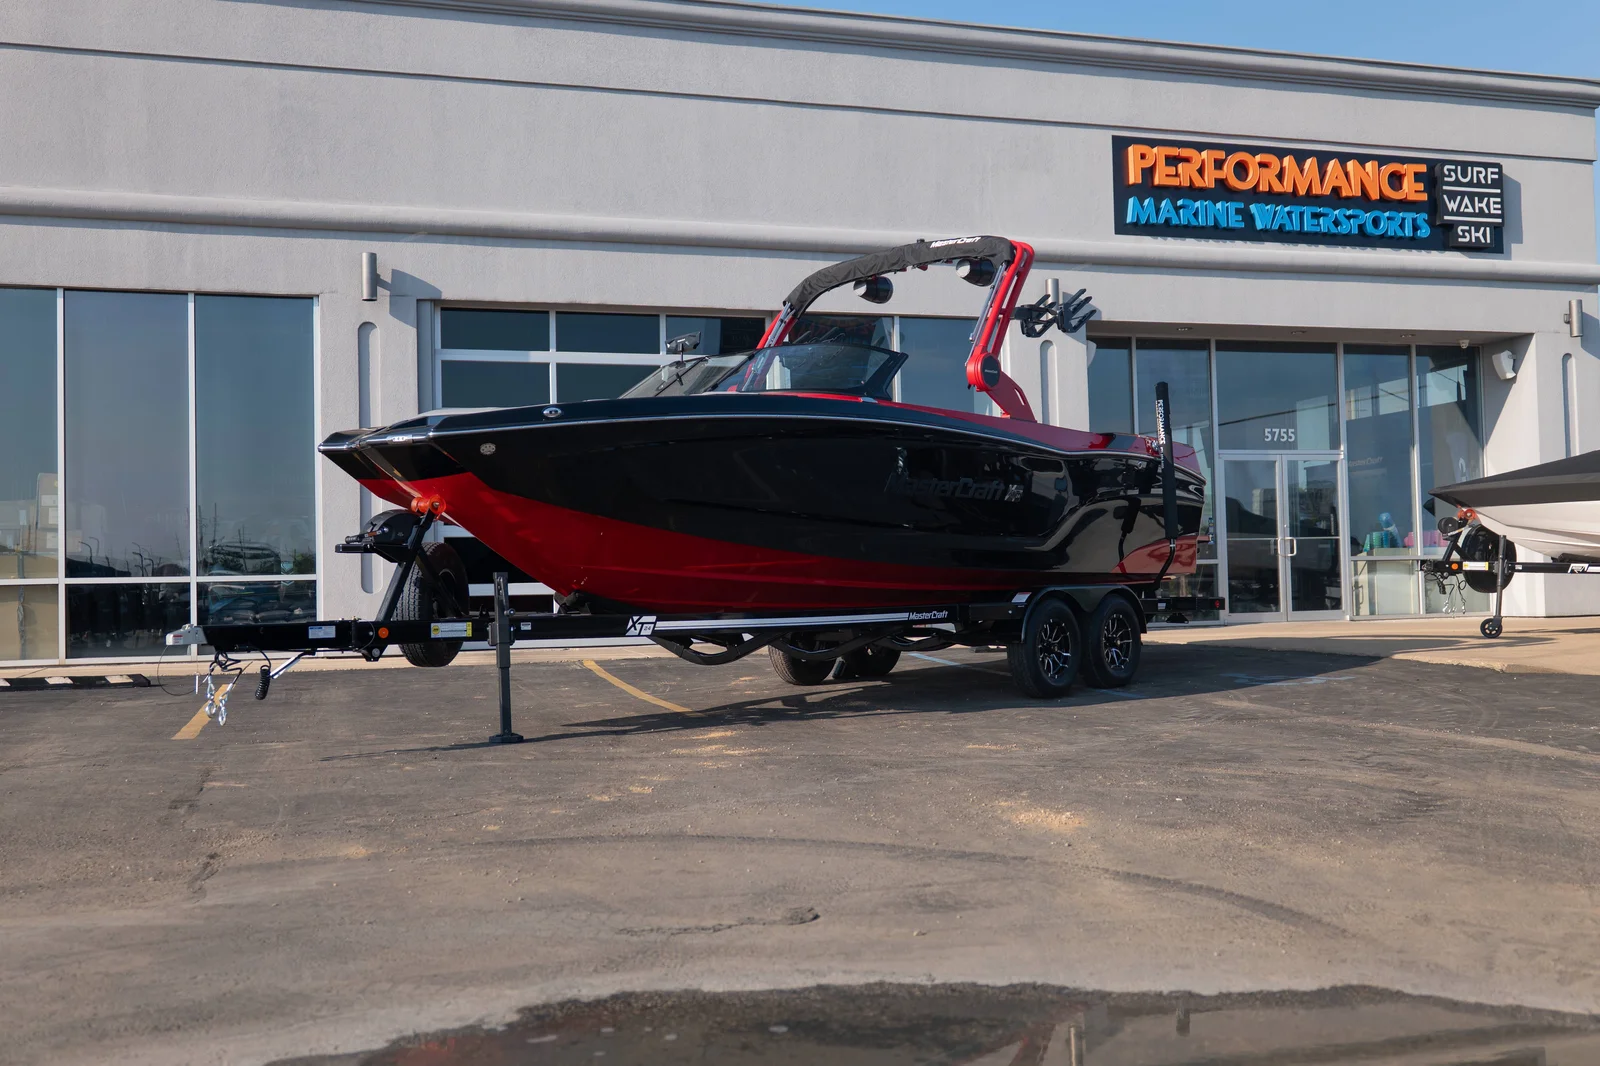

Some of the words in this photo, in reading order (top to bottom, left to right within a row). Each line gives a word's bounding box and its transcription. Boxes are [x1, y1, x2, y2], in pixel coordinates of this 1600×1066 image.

[1127, 143, 1428, 202] PERFORMANCE
[1443, 164, 1499, 185] SURF
[1443, 194, 1502, 214] WAKE
[1126, 196, 1245, 229] MARINE
[1249, 202, 1431, 239] WATERSPORTS
[1457, 225, 1492, 244] SKI
[1264, 428, 1296, 442] 5755
[884, 471, 1006, 501] MasterCraft
[624, 615, 656, 636] XT
[908, 610, 948, 620] MasterCraft
